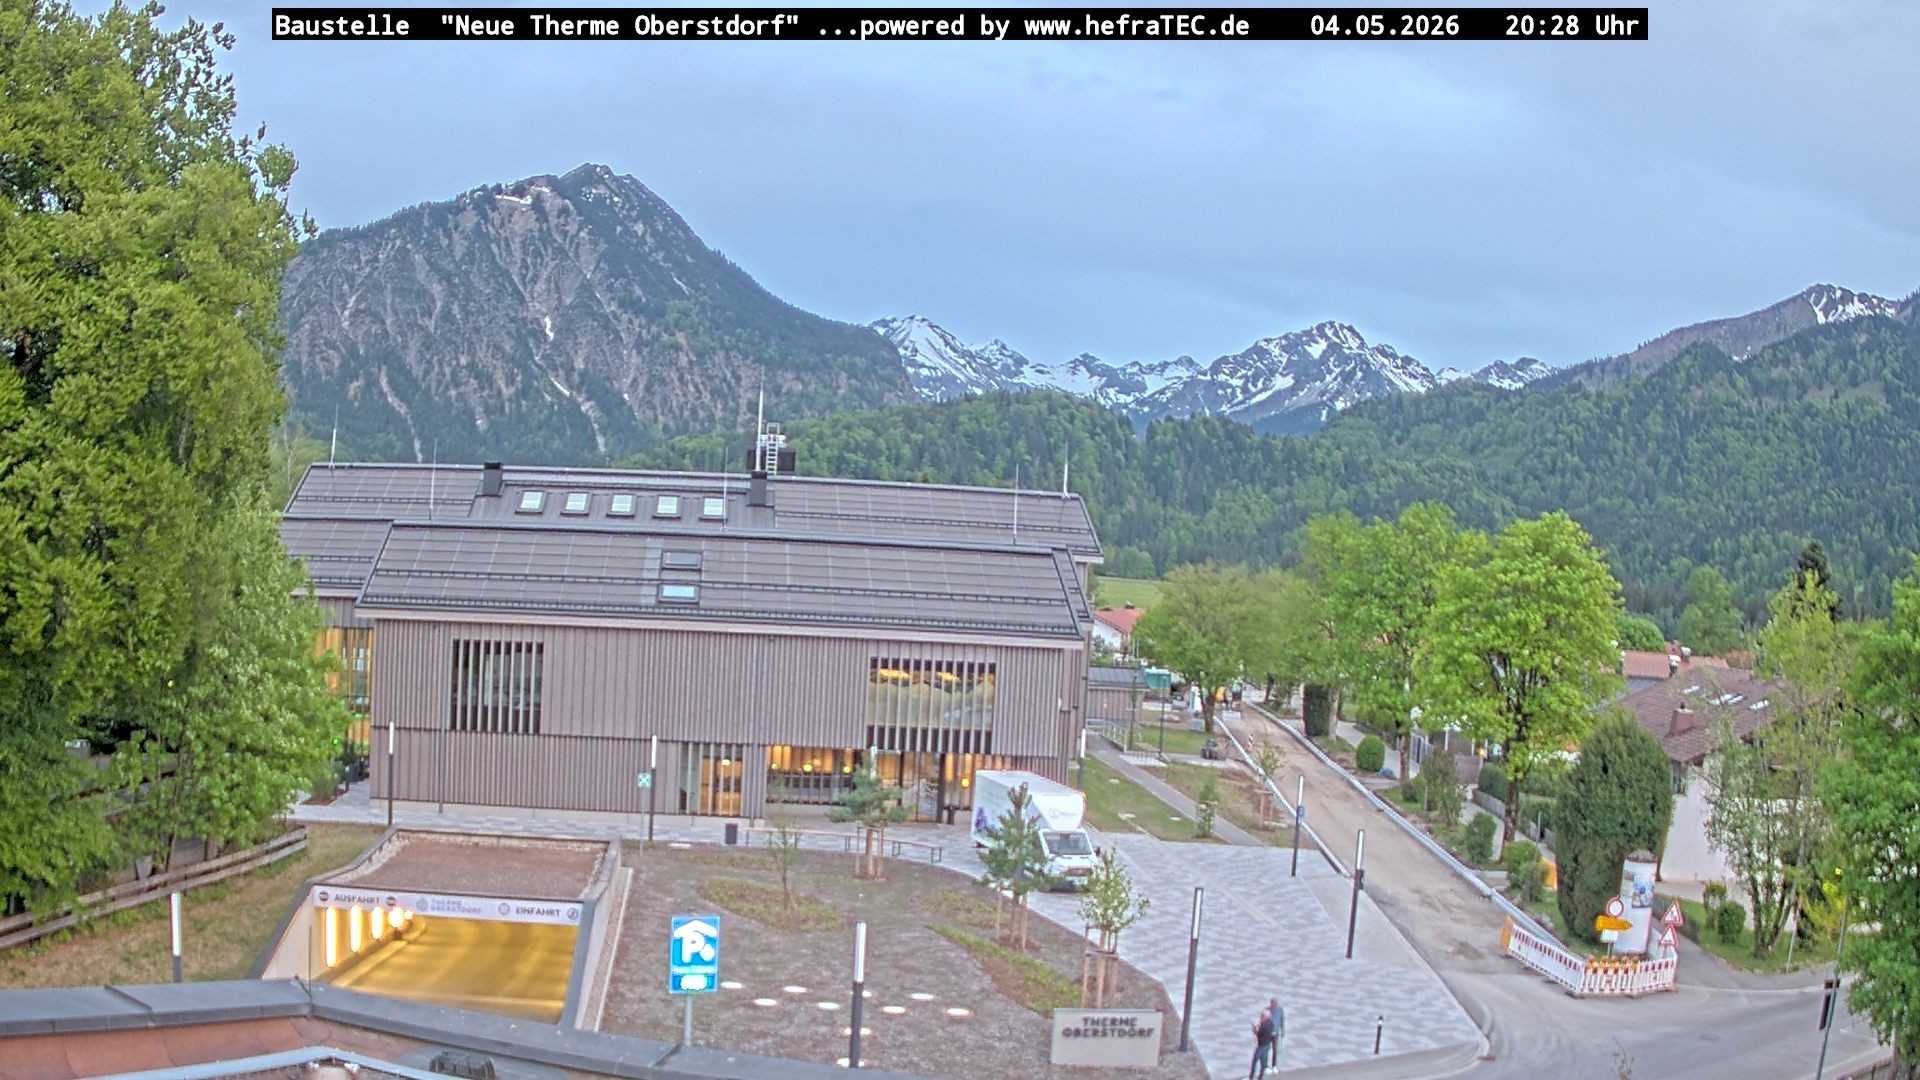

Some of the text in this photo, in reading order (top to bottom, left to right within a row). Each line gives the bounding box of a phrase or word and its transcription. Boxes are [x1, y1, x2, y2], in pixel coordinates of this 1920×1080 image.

[515, 906, 562, 917] EINFAHRT
[1082, 1016, 1138, 1027] THERME
[1062, 1027, 1154, 1038] OBERSTDORF
